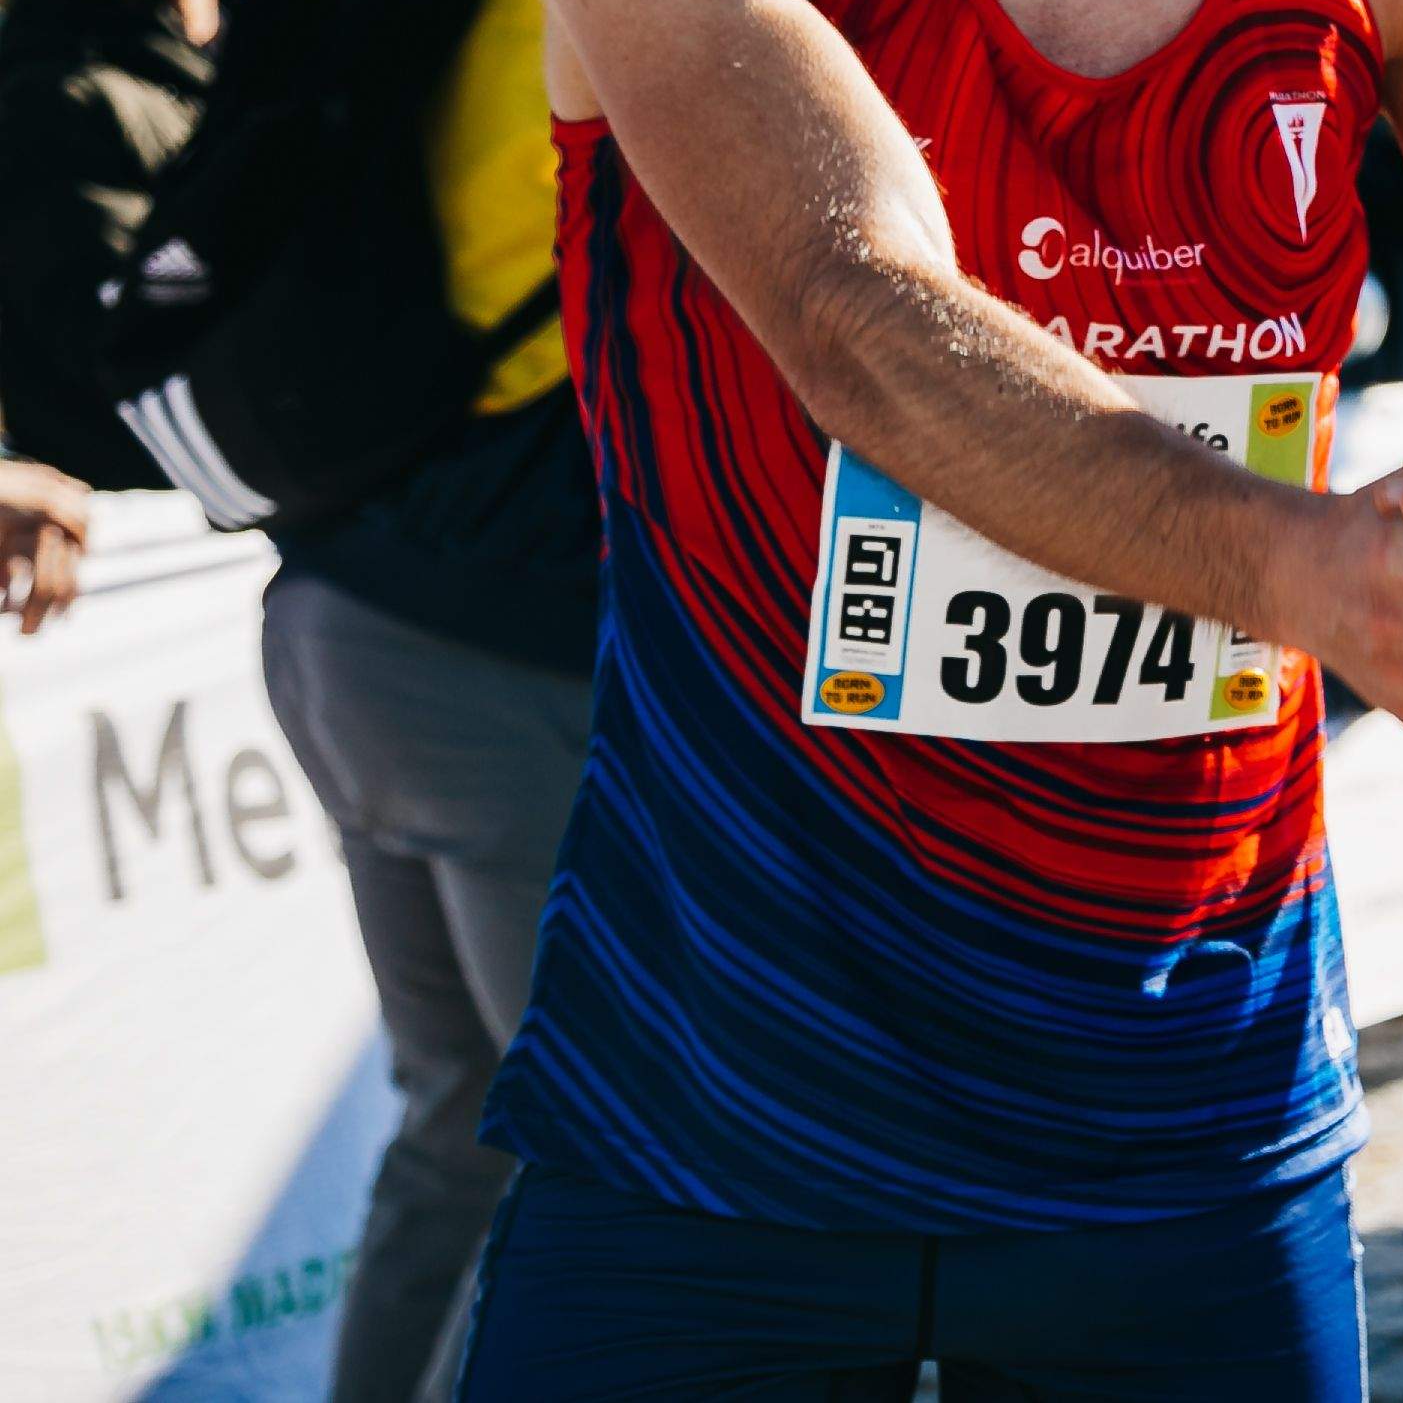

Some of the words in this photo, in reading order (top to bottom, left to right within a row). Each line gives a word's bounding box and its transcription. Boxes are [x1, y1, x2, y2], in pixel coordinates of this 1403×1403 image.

[1069, 229, 1206, 286] alquiber
[1046, 312, 1307, 363] ARATHON
[940, 590, 1195, 707] 3974
